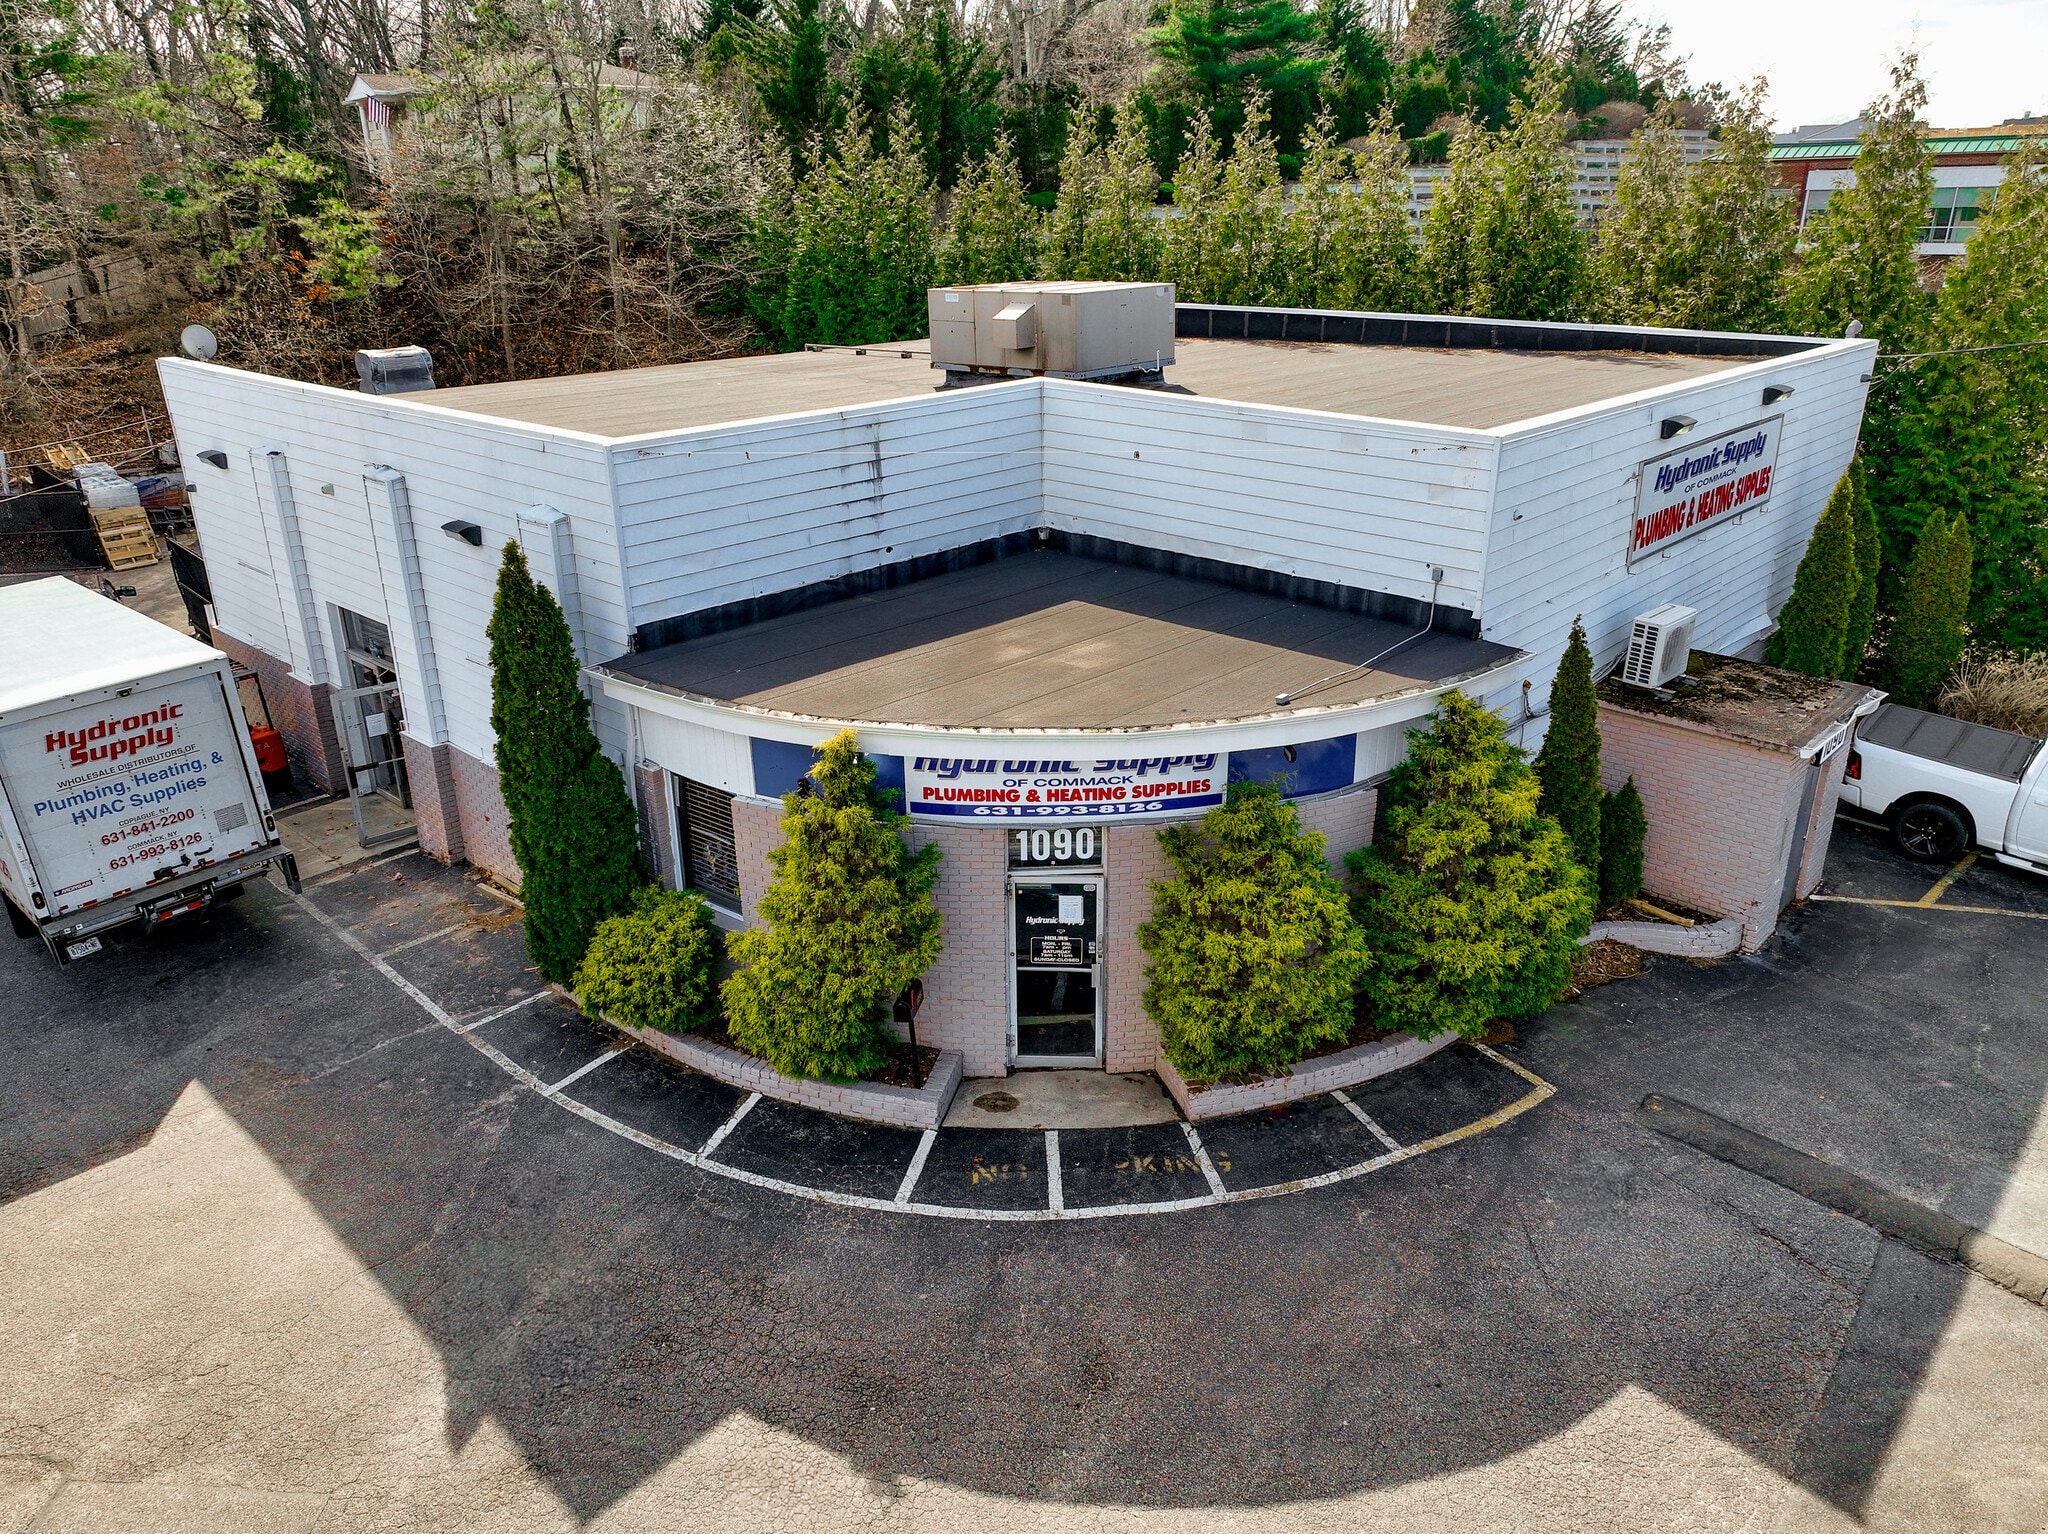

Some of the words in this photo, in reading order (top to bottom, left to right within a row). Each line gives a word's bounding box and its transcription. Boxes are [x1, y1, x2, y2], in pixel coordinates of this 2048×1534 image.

[1654, 447, 1723, 494] Hydronic
[1721, 431, 1767, 467] Supply
[1684, 483, 1697, 494] OF
[1696, 467, 1738, 488] COMMACK
[1633, 500, 1686, 552] PLUMBING
[1686, 497, 1696, 528] &
[1695, 480, 1735, 524] HEATING
[1734, 465, 1772, 507] SUPPLIES
[45, 703, 184, 753] Hydronic
[69, 726, 174, 767] Supply
[33, 781, 131, 817] Plumbing,
[133, 758, 208, 787] Heating,
[211, 751, 224, 764] &
[56, 766, 116, 789] WHOLESALE
[118, 748, 184, 772] DISTRIBUTORS
[185, 743, 197, 752] OF
[1002, 778, 1029, 787] OF
[1033, 775, 1134, 787] COMMACK
[71, 799, 125, 826] HVAC
[129, 776, 207, 808] Supplies
[922, 787, 1021, 802] PLUMBING
[1025, 789, 1041, 802] &
[1046, 786, 1127, 802] HEATING
[1131, 778, 1211, 799] SUPPLIES
[973, 800, 1163, 816] 631-993-8126
[101, 808, 195, 846] 631-841-2200
[159, 806, 170, 815] NY
[109, 831, 203, 870] 631-993-8126
[167, 830, 178, 839] NY
[1015, 828, 1095, 861] 1090
[1026, 916, 1058, 925] Hydronic
